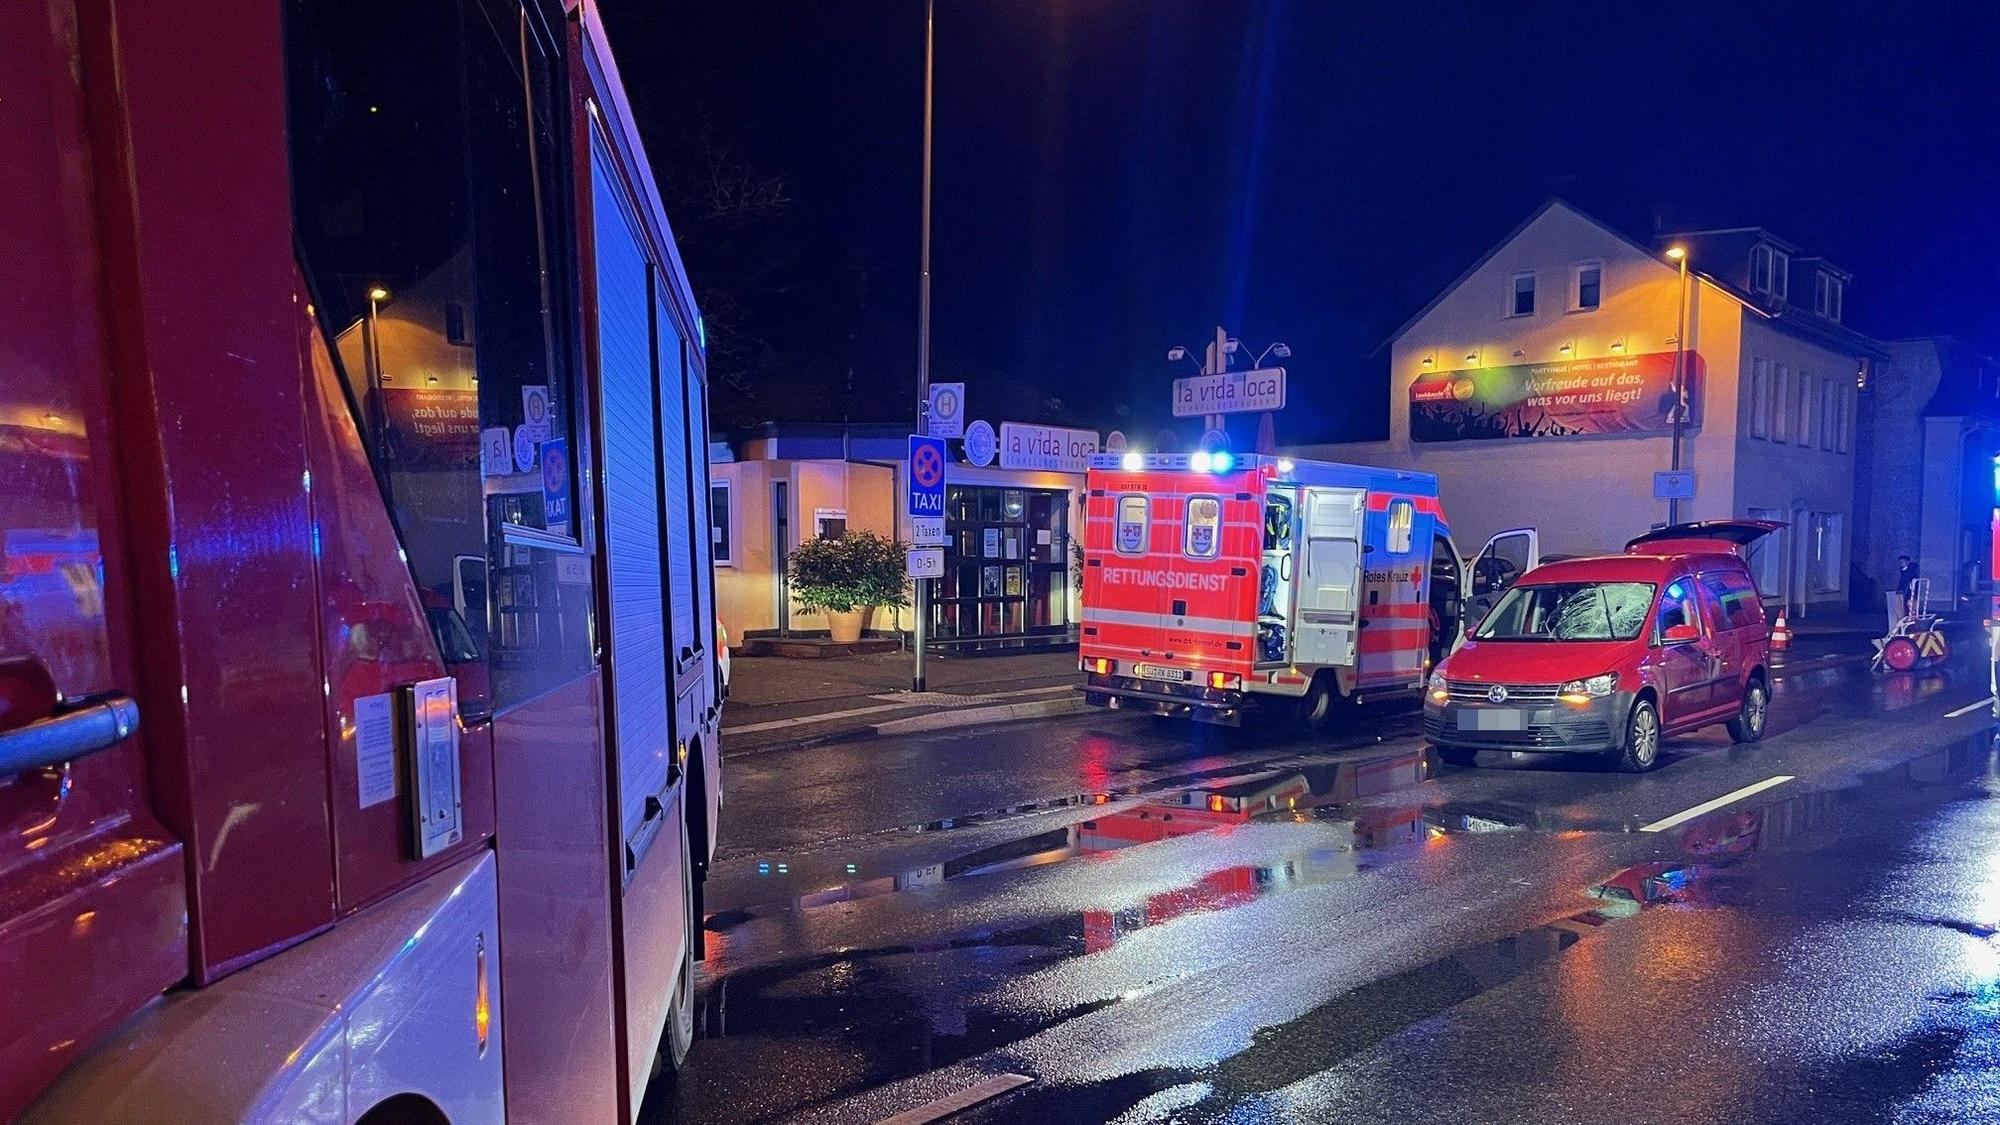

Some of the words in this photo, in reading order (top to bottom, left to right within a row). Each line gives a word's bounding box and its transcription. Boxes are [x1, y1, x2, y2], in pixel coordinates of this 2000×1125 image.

[1178, 382, 1193, 402] la
[1200, 376, 1235, 401] vida
[1243, 375, 1276, 397] loca
[1525, 376, 1588, 393] Vorfreude
[1591, 373, 1616, 388] auf
[1616, 371, 1645, 386] das,
[941, 395, 952, 412] H
[1527, 396, 1552, 407] was
[1555, 395, 1577, 406] vor
[1579, 393, 1602, 404] uns
[1605, 387, 1642, 404] liegt!
[1006, 426, 1020, 454] la
[1028, 430, 1060, 457] vida
[1067, 431, 1095, 458] loca
[912, 492, 941, 511] TAXI
[915, 525, 920, 537] 2
[921, 525, 941, 537] Taxen
[1103, 567, 1228, 592] RETTUNGSDIENST
[1364, 570, 1386, 583] Rotes
[1388, 570, 1409, 583] Kreuz
